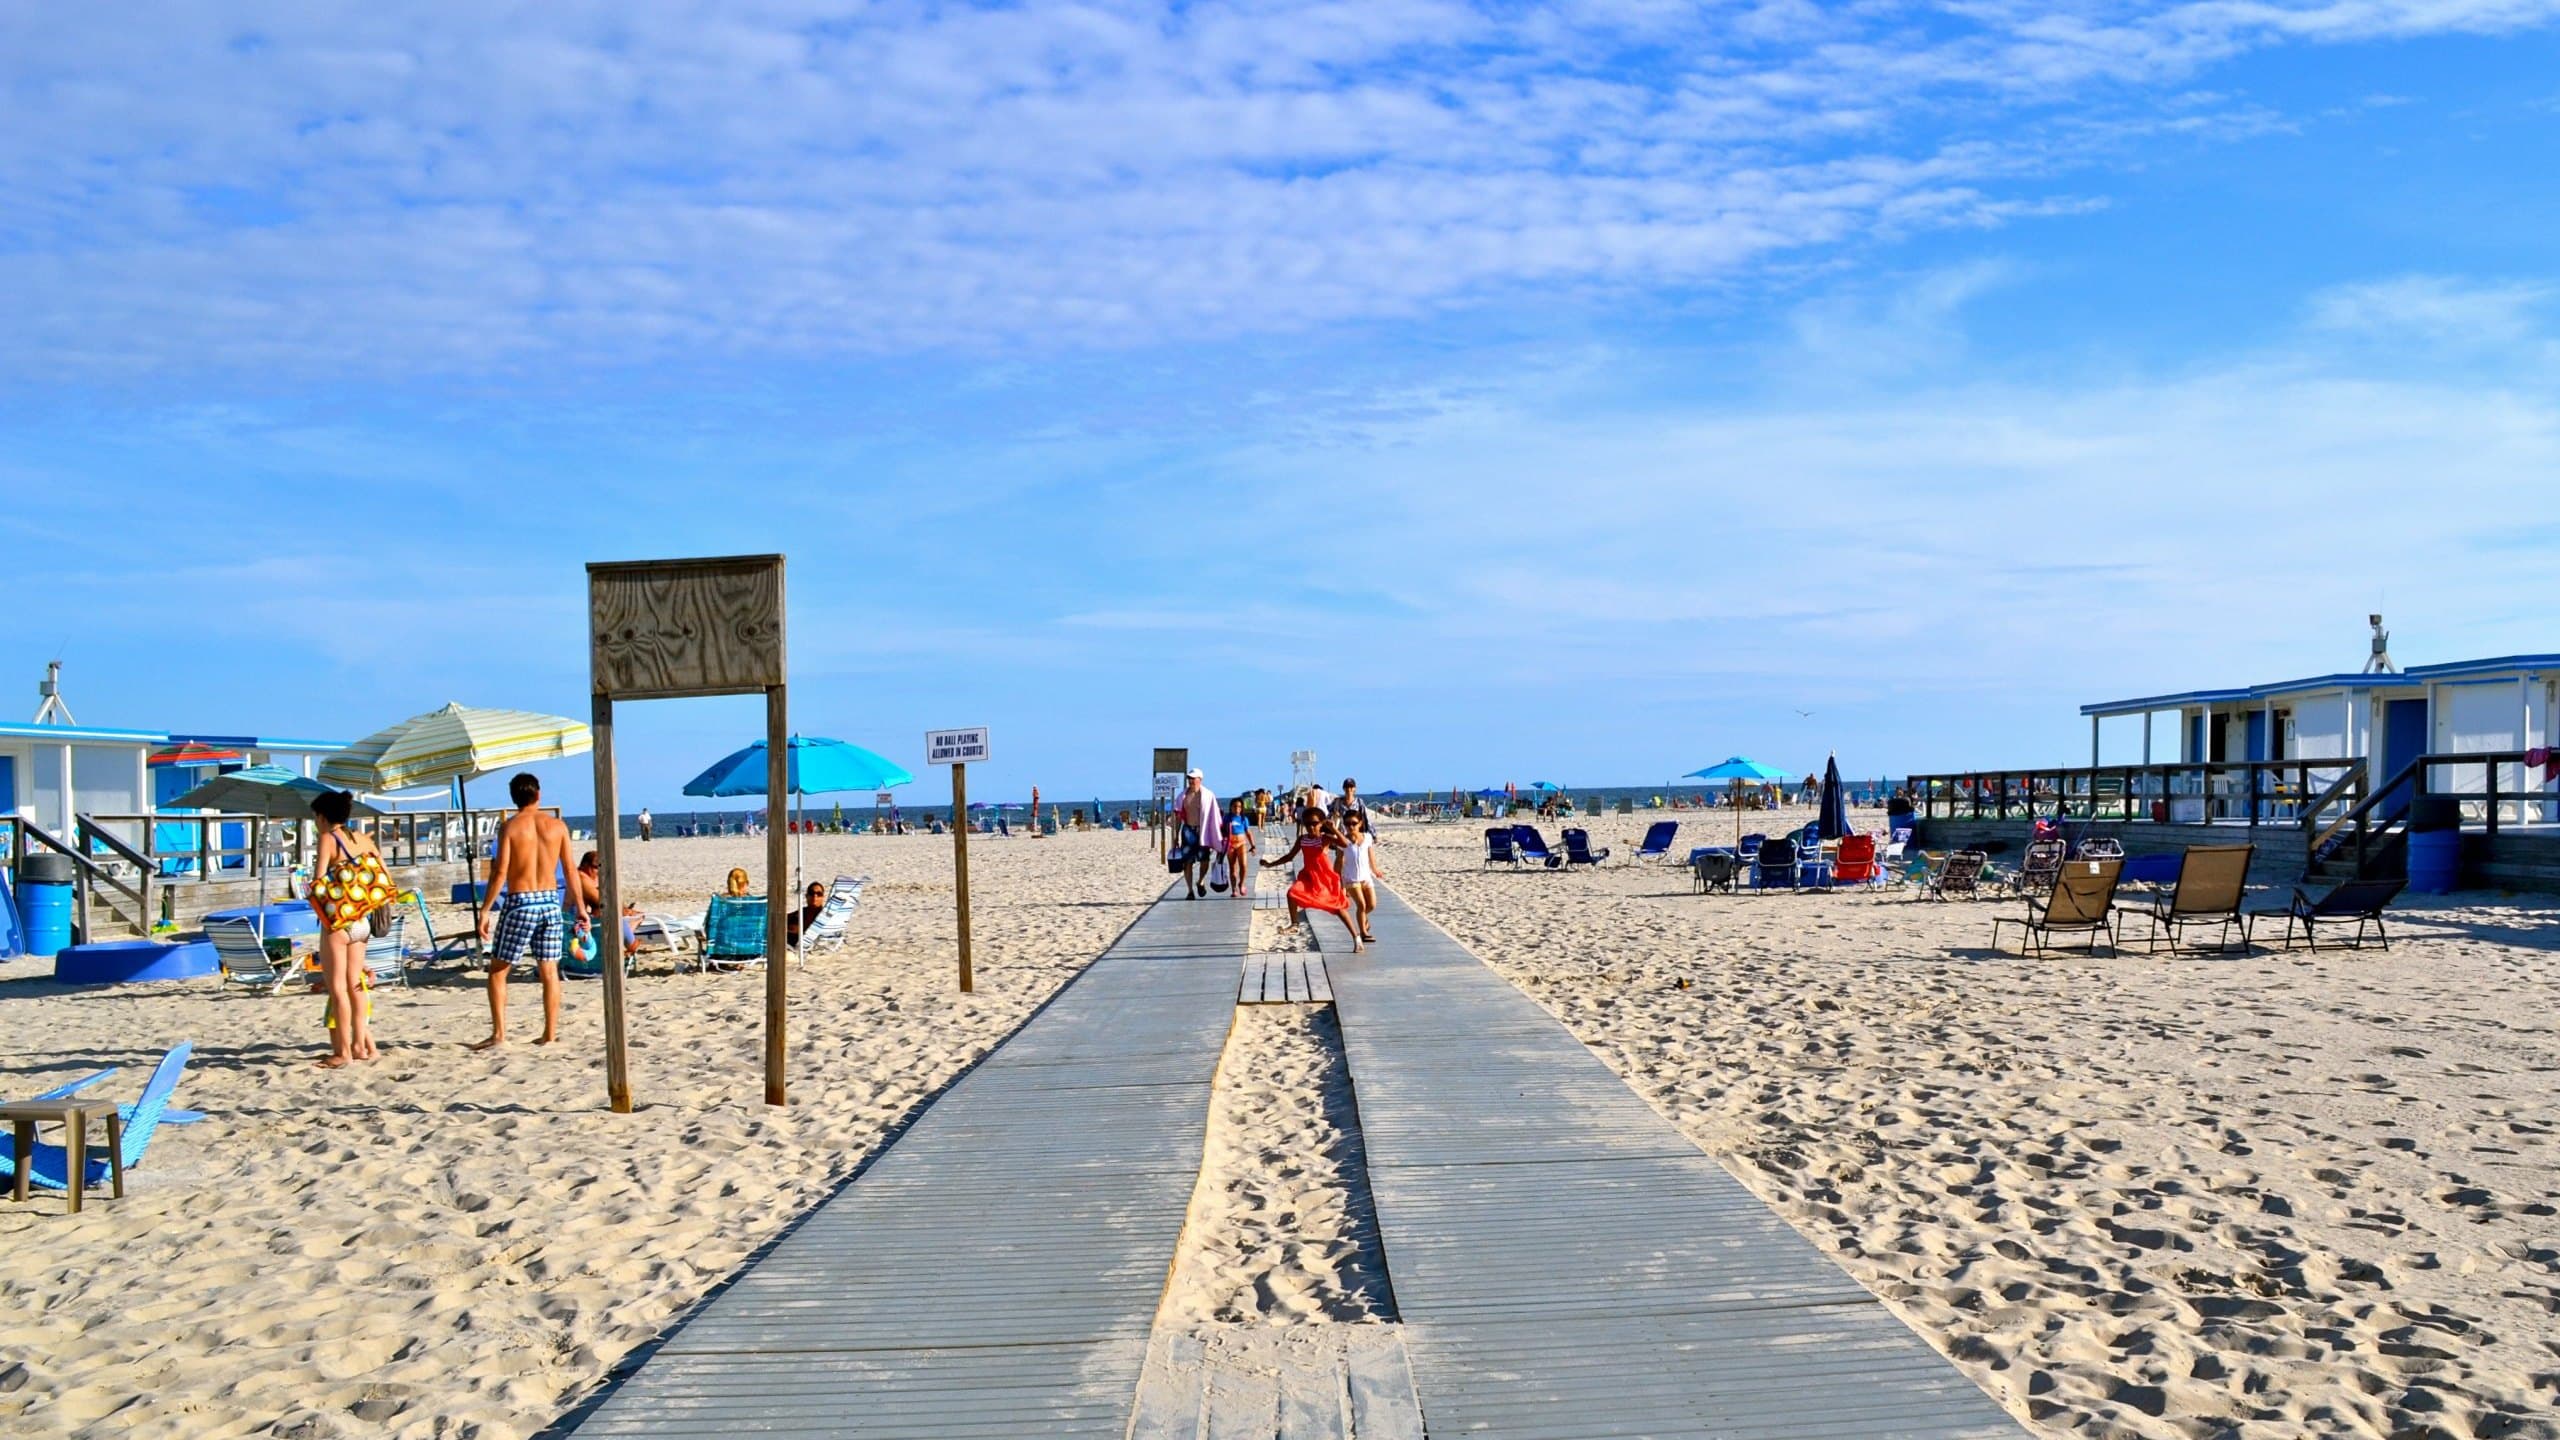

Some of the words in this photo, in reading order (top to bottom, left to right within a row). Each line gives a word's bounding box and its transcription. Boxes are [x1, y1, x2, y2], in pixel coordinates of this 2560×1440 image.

[936, 736, 943, 746] NO
[944, 735, 956, 746] BALL
[957, 733, 979, 745] PLAYING
[932, 748, 954, 759] ALLOWED
[955, 747, 961, 757] IN
